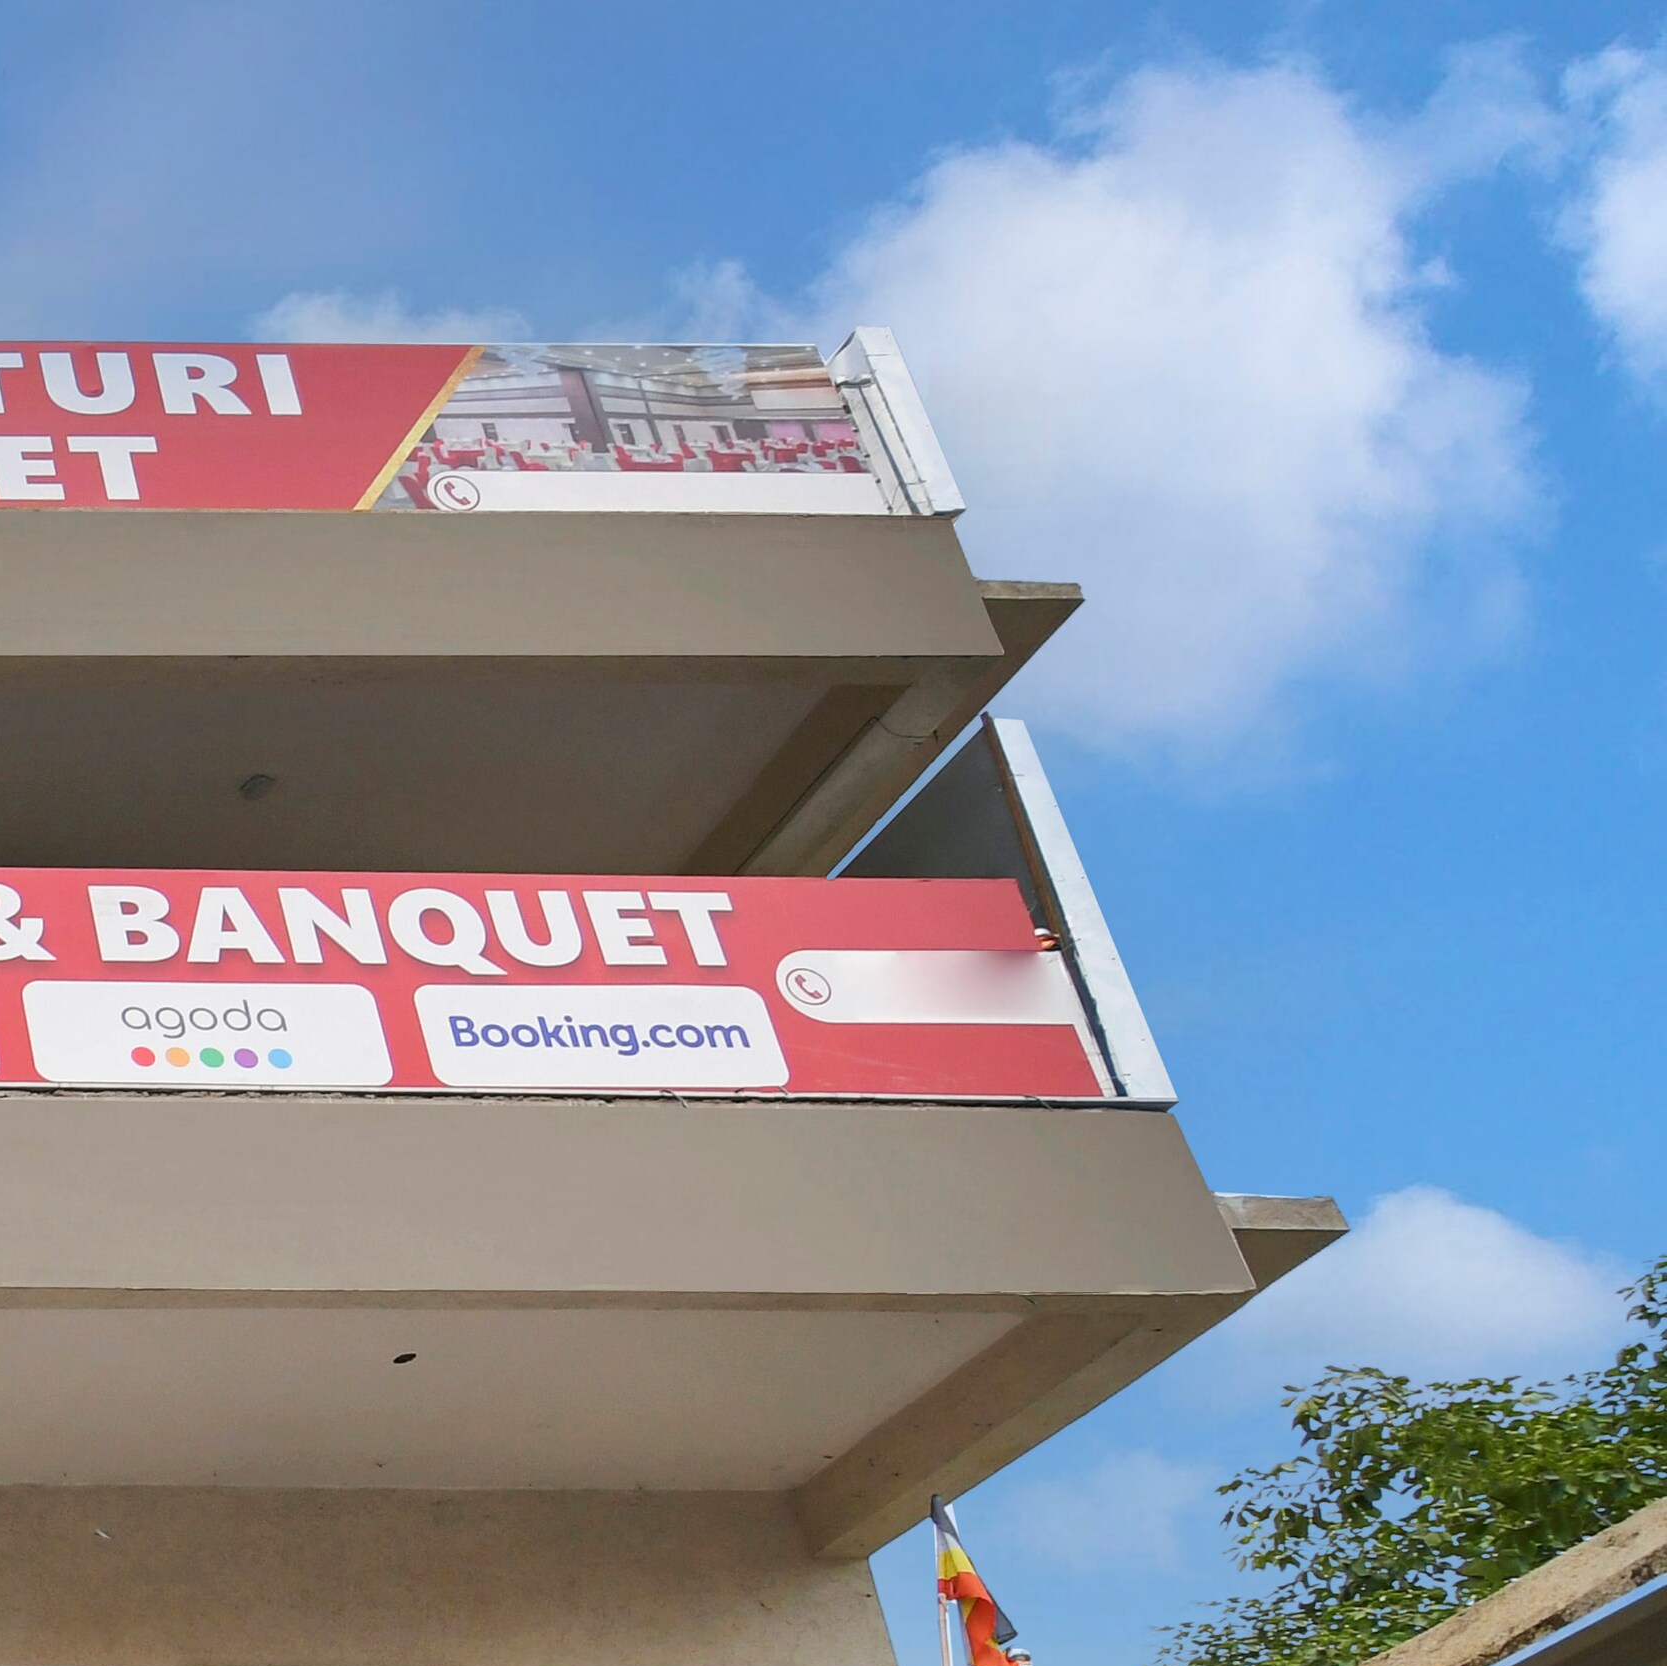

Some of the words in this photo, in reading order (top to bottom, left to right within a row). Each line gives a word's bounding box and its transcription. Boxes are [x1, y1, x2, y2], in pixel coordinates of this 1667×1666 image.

[87, 884, 734, 976] BANQUET
[120, 999, 289, 1039] agoda
[447, 1014, 751, 1056] Booking.com
